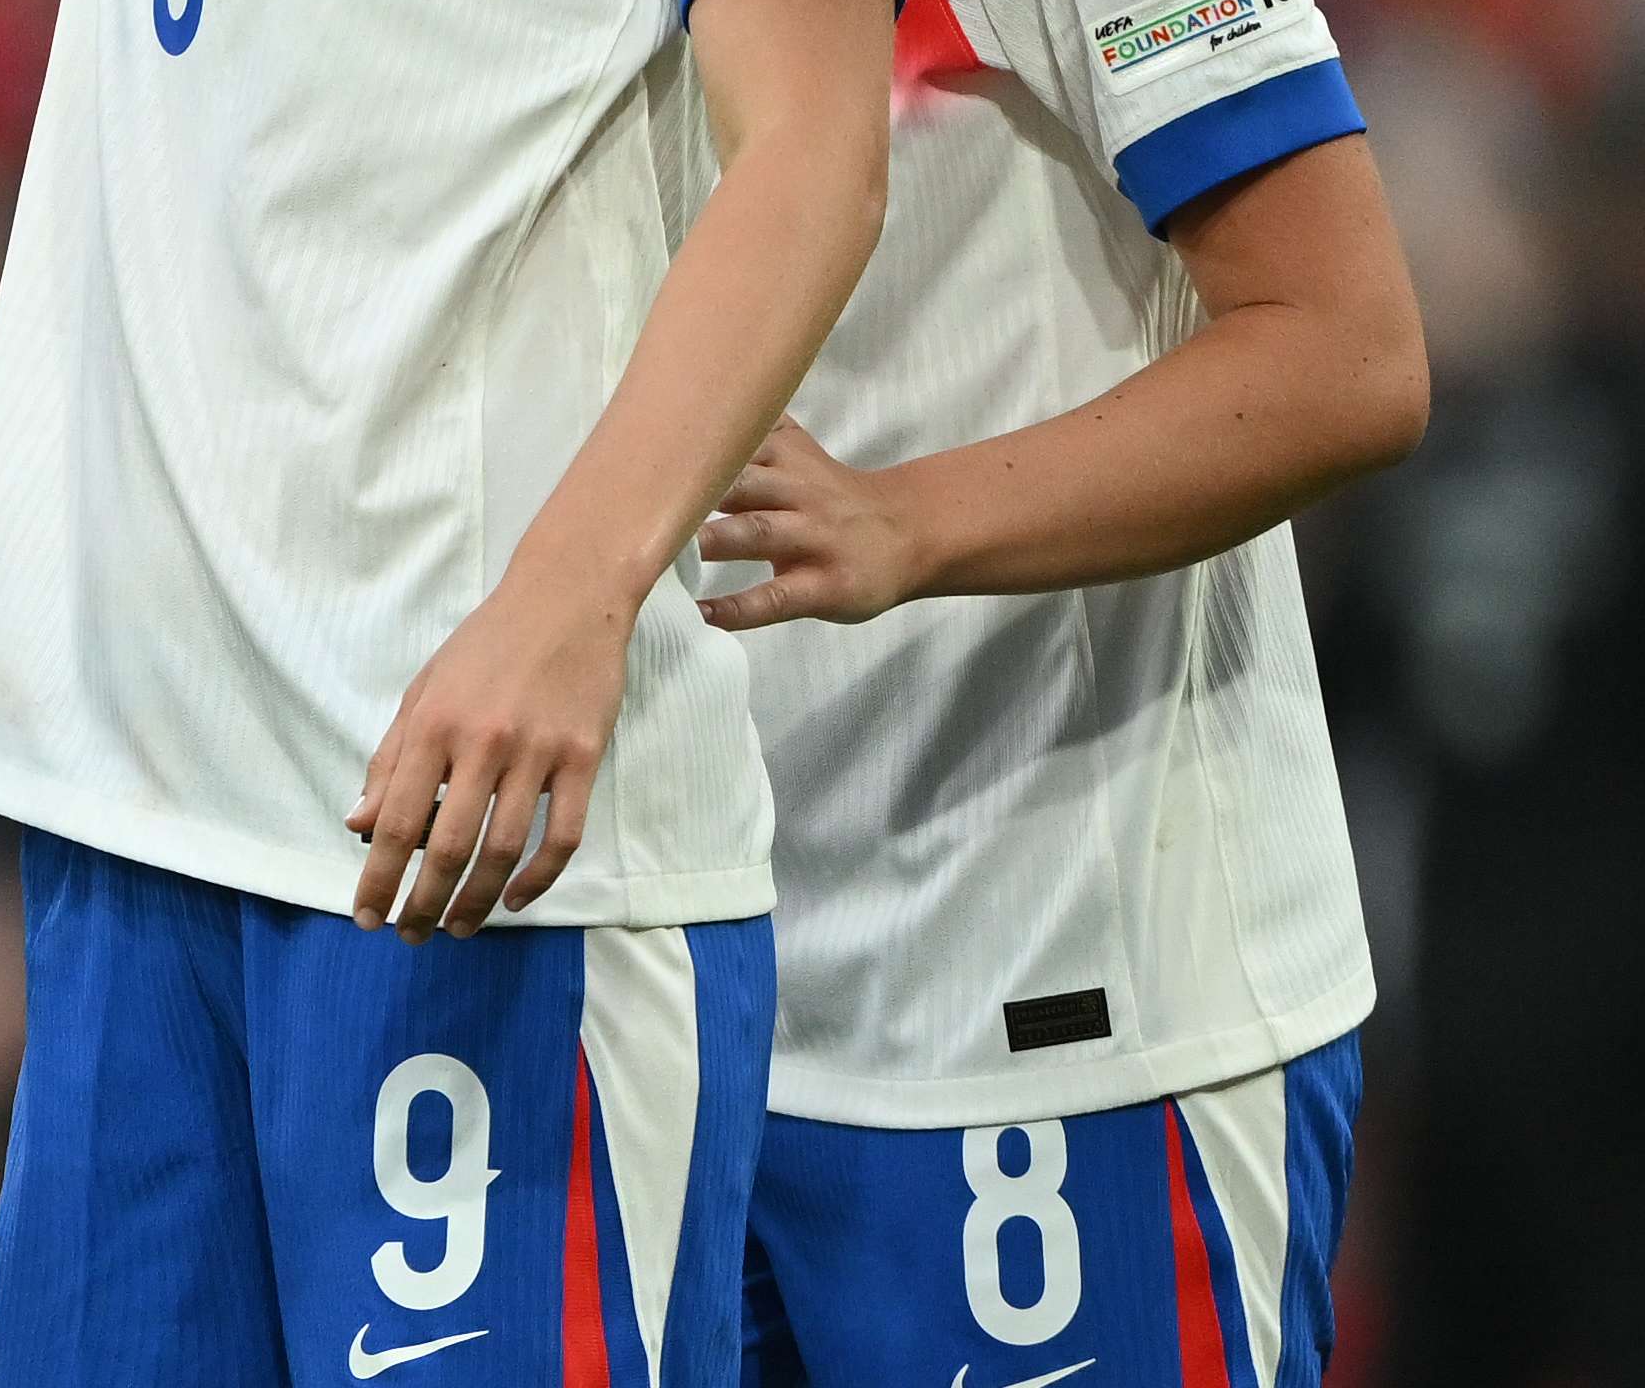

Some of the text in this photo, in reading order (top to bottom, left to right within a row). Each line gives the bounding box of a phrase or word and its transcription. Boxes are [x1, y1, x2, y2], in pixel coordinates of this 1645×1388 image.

[1095, 15, 1134, 41] UEFA
[1210, 21, 1262, 51] for children
[371, 1053, 502, 1311] 9
[962, 1126, 1083, 1346] 8
